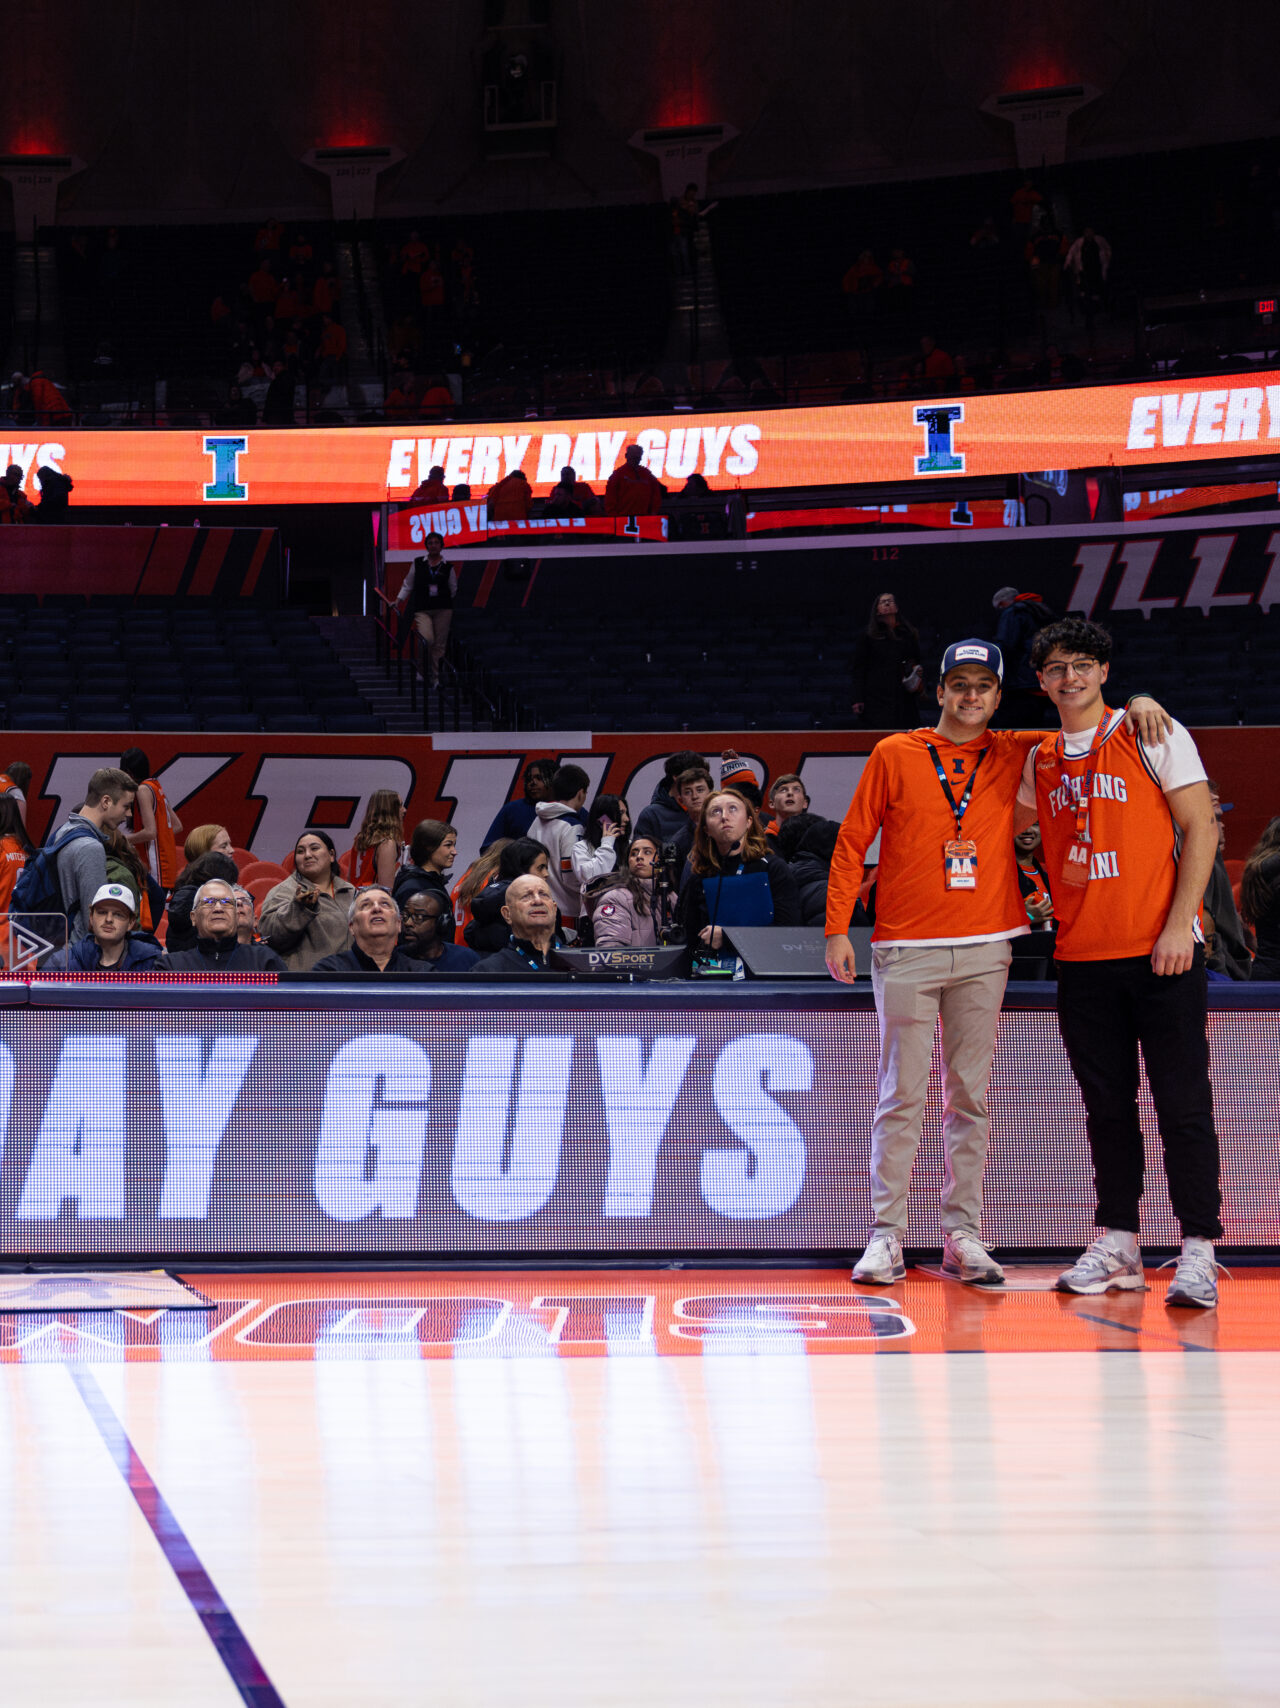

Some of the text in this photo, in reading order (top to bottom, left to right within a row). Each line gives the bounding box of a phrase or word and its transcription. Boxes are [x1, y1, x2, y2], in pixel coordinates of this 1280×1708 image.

[386, 423, 762, 488] EVERY DAY GUYS
[871, 547, 900, 561] 112
[1068, 845, 1088, 865] AA
[951, 858, 973, 874] AA
[313, 1033, 815, 1223] GUYS
